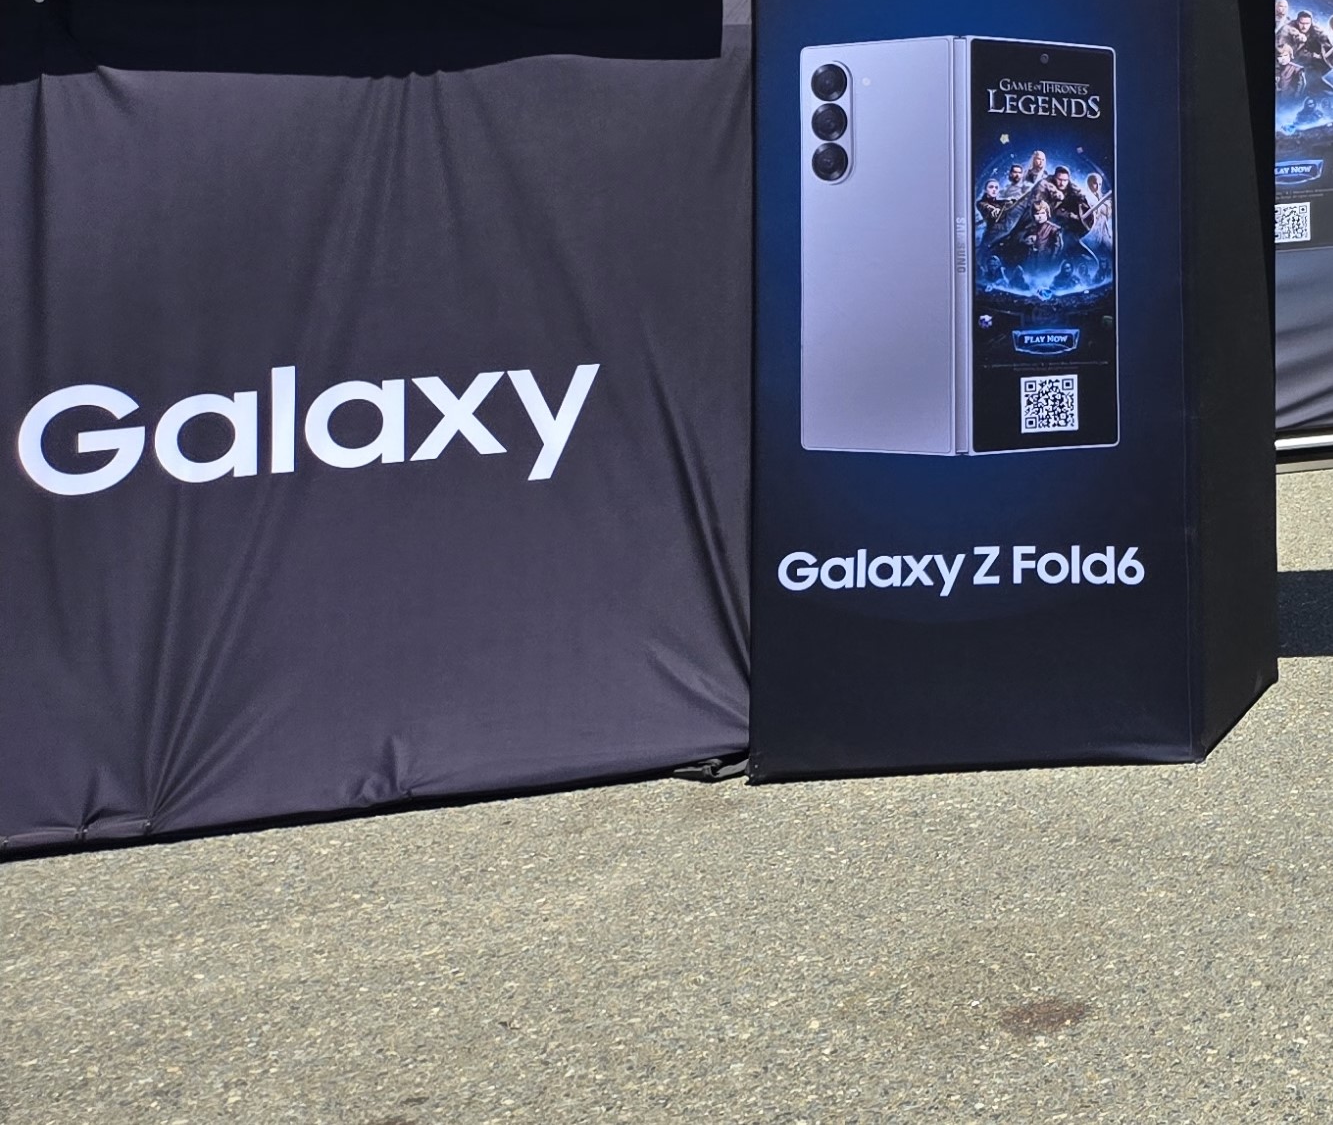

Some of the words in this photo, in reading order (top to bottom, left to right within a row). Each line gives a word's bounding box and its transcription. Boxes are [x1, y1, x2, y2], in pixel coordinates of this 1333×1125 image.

[999, 78, 1033, 92] GAME
[1039, 80, 1090, 95] THRONES
[987, 88, 1101, 119] LEGENDS
[1024, 335, 1046, 344] PLAY
[1046, 334, 1068, 343] NOW
[17, 363, 601, 498] Galaxy
[777, 548, 966, 597] Galaxy
[972, 547, 1000, 585] Z
[1012, 544, 1146, 586] Fold6
